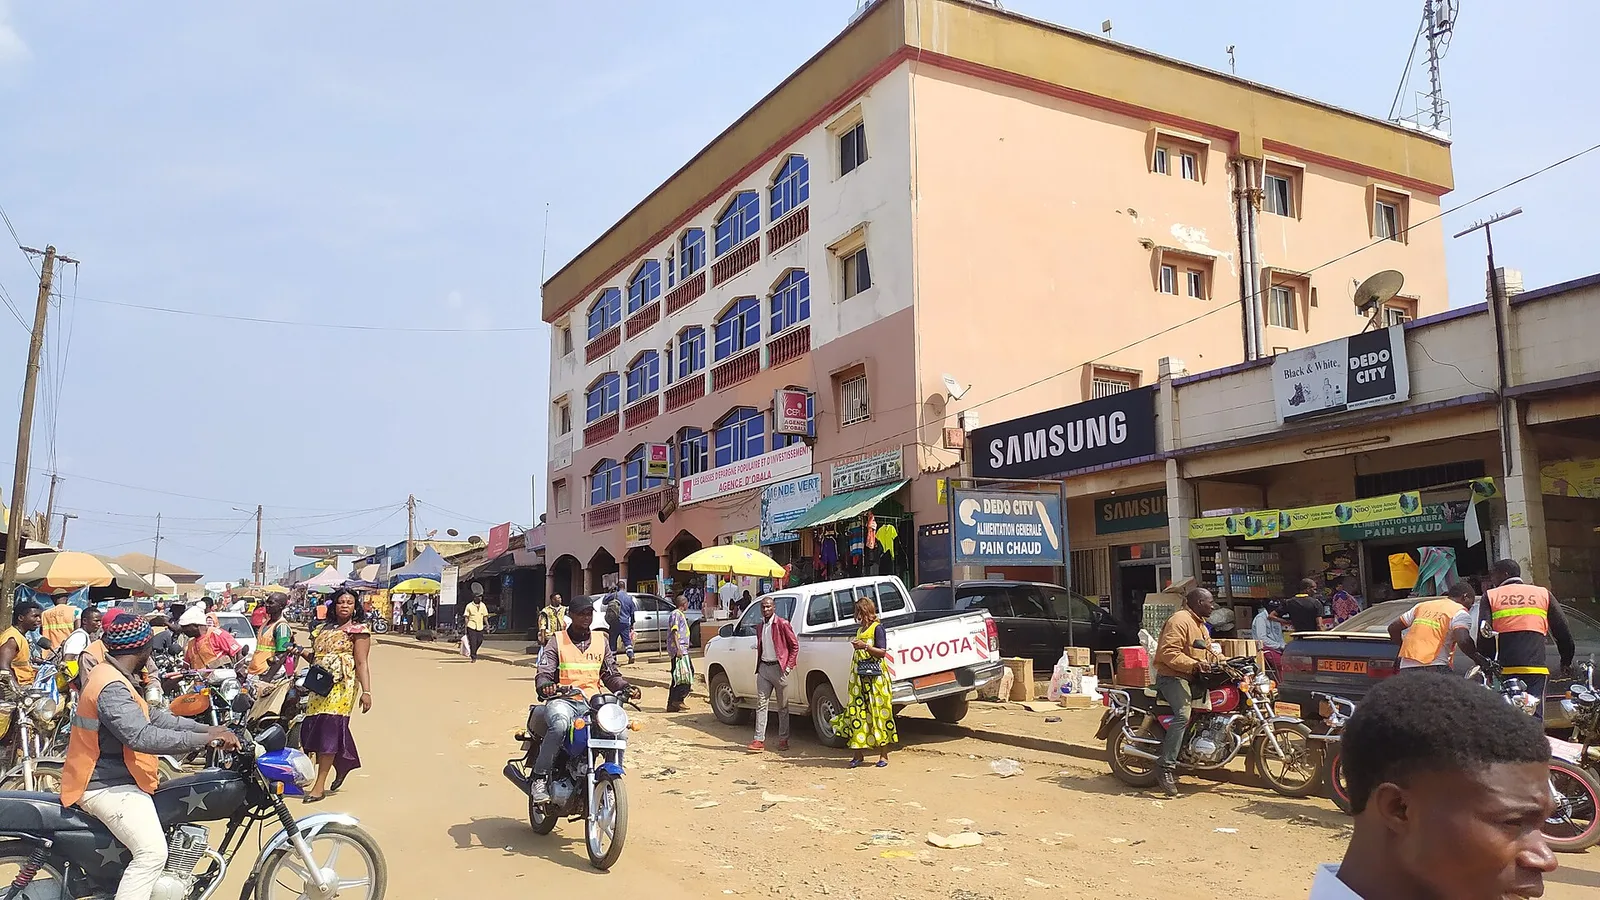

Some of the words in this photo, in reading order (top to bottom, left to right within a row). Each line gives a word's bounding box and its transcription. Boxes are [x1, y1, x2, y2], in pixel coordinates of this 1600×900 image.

[1349, 349, 1390, 370] DEDO
[1284, 365, 1305, 380] Black
[1306, 363, 1314, 375] &
[1355, 365, 1387, 385] CITY
[988, 409, 1129, 470] SAMSUNG
[700, 472, 715, 484] CAISSES
[737, 459, 761, 475] POPULAIRE
[761, 459, 767, 468] ET
[718, 477, 743, 492] AGENCE
[766, 482, 796, 500] MONDE
[797, 477, 819, 492] VERT
[982, 498, 1012, 515] DEDO
[1012, 499, 1035, 516] CITY
[976, 521, 1016, 537] ALIMENTATION
[1015, 522, 1042, 537] GENERALE
[1352, 517, 1409, 529] ALIMENTATION
[1410, 514, 1444, 523] GENERA
[1364, 528, 1395, 537] PAIN
[1399, 522, 1442, 534] CHAUD
[979, 541, 1005, 555] PAIN
[1006, 541, 1042, 555] CHAUD
[897, 636, 973, 665] TOYOTA
[1324, 660, 1333, 670] CE
[1336, 661, 1351, 671] 087
[1353, 661, 1365, 672] AY
